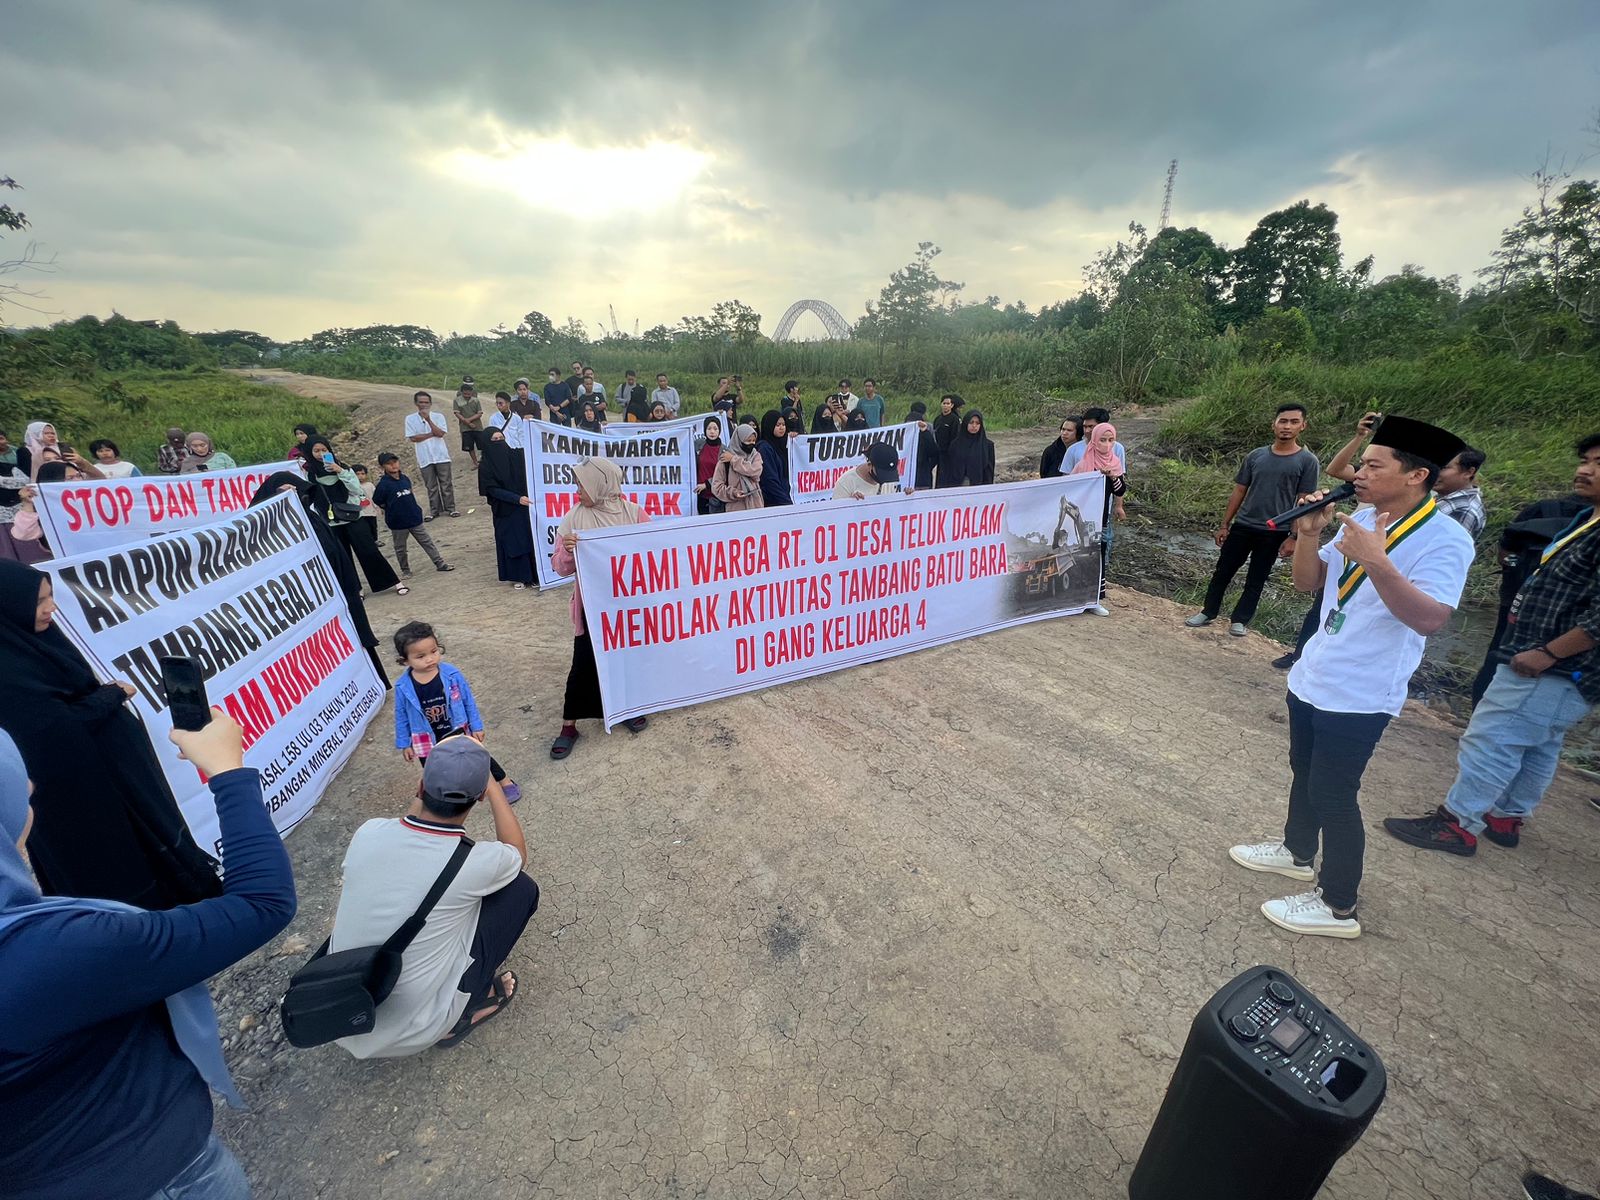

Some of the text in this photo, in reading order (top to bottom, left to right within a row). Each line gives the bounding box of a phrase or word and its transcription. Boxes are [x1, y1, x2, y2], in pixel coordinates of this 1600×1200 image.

[541, 431, 681, 458] KAMI WARGA
[542, 464, 575, 485] DES
[632, 465, 682, 485] DALAM
[797, 469, 831, 494] KEPALA
[61, 473, 271, 532] STOP DAN TANG
[58, 497, 310, 633] APAPUN ALASANNYA
[610, 547, 679, 598] KAMI
[687, 534, 770, 586] WARGA
[778, 528, 806, 570] RT.
[814, 524, 839, 564] 01
[846, 517, 892, 560] DESA
[899, 509, 948, 550] TELUK
[951, 503, 1005, 541] DALAM
[236, 568, 317, 641] ILEGAL
[302, 555, 335, 606] ITU
[601, 552, 1008, 652] MENOLAK AKTIVITAS TAMBANG BATU BARA
[735, 599, 927, 675] DI GANG KELUARGA 4
[260, 615, 355, 718] HUKUMNYA
[260, 680, 359, 792] ASAL 158 UU 03 TAHUN 2020
[308, 732, 345, 775] MINERAL
[337, 719, 355, 739] DAN
